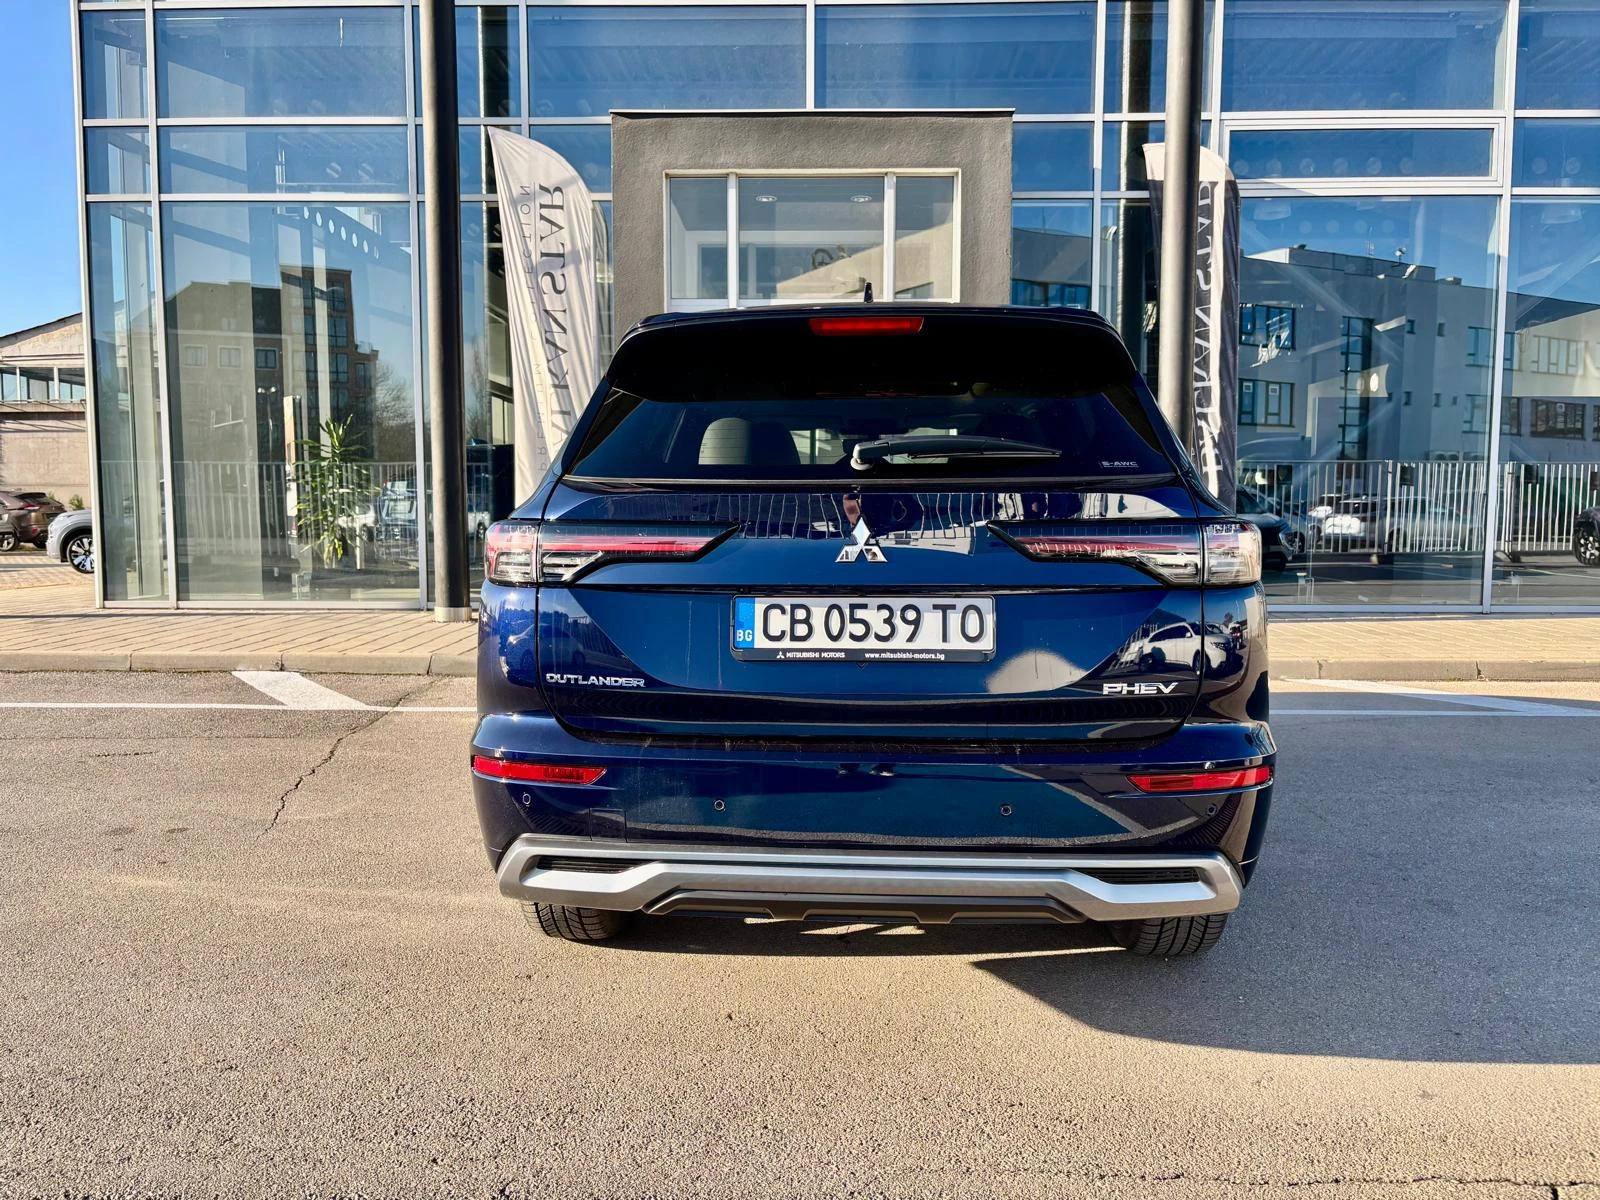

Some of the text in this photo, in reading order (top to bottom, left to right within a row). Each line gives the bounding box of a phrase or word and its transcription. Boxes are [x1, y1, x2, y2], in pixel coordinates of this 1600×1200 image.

[763, 603, 985, 643] CB 0539 TO
[736, 629, 753, 642] BG
[864, 652, 945, 660] www.mitsubishi-motors.bg
[546, 673, 646, 687] OUTLANDER
[1103, 682, 1179, 695] PHEV
